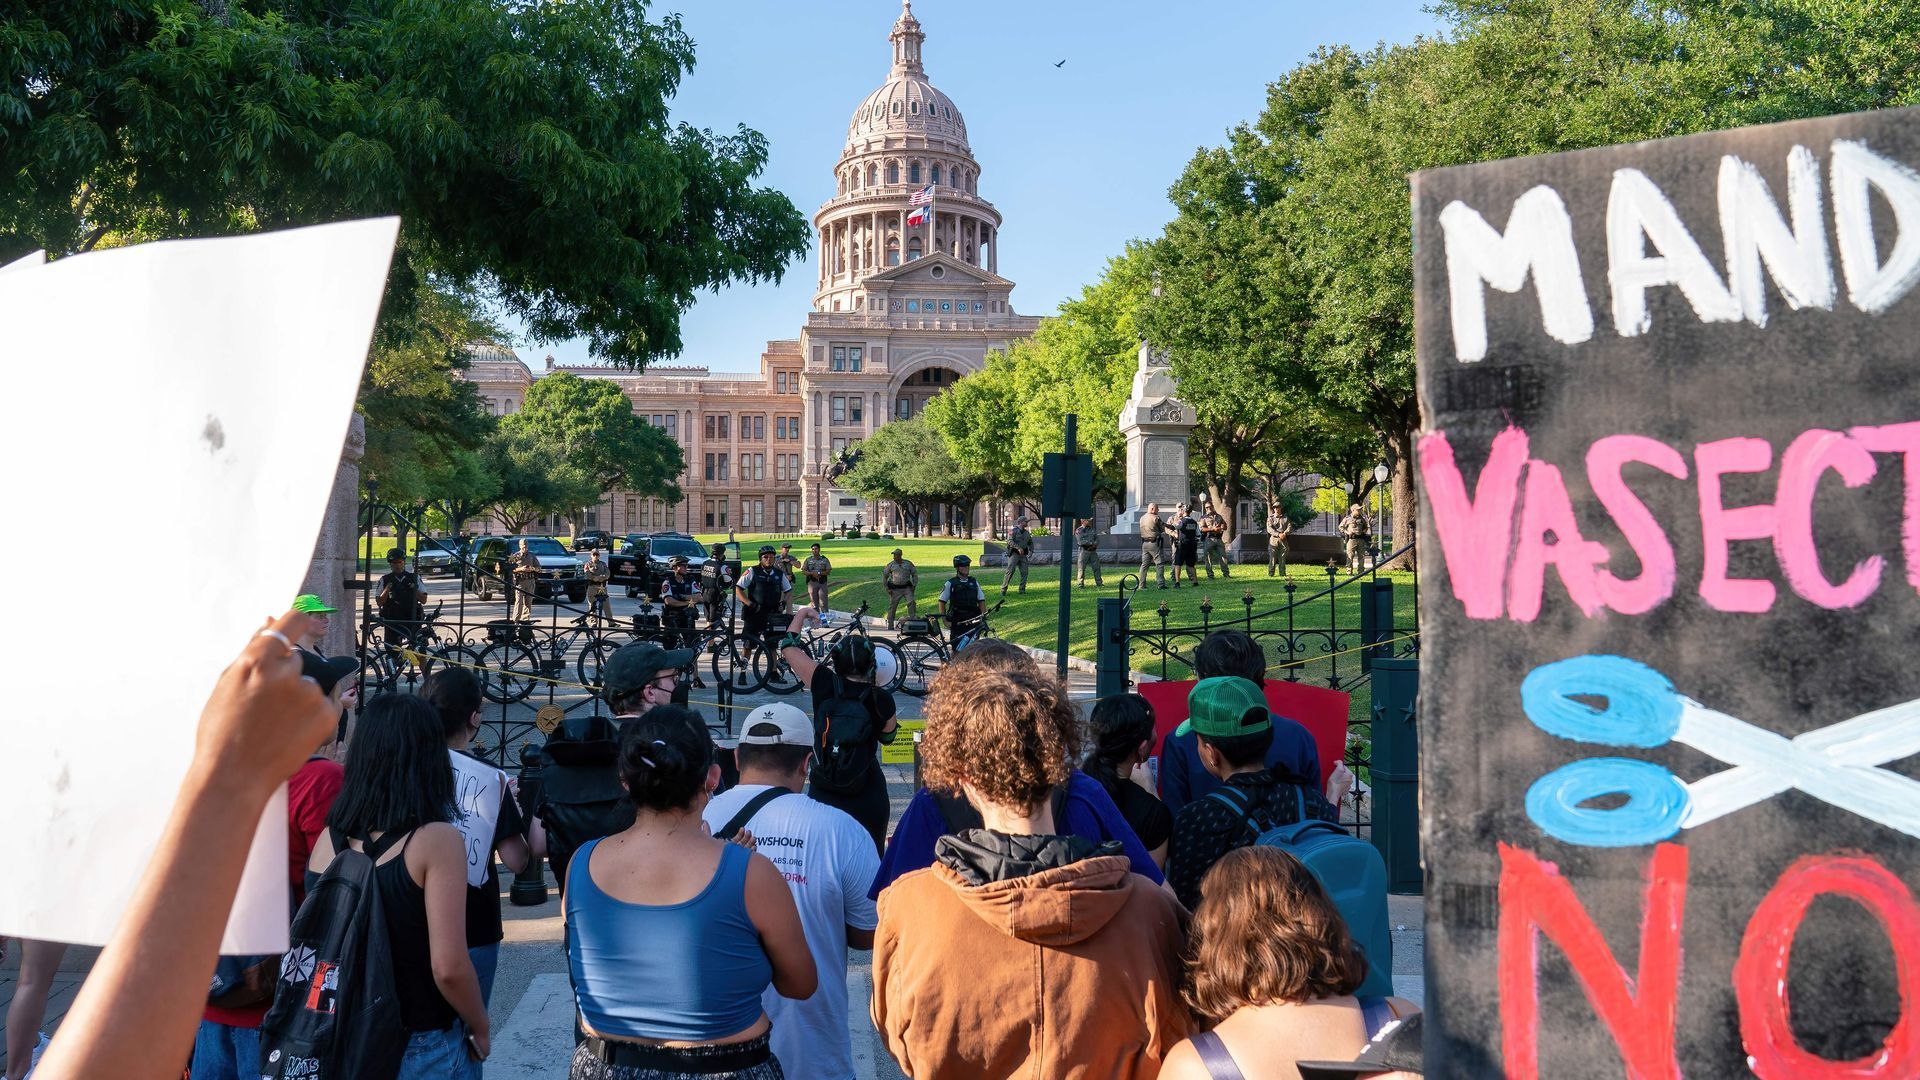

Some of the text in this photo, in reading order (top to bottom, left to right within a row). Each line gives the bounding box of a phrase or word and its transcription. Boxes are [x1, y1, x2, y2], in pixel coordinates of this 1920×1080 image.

[1439, 138, 1920, 363] MAND
[1416, 421, 1920, 622] VASECT
[1497, 841, 1920, 1080] NO
